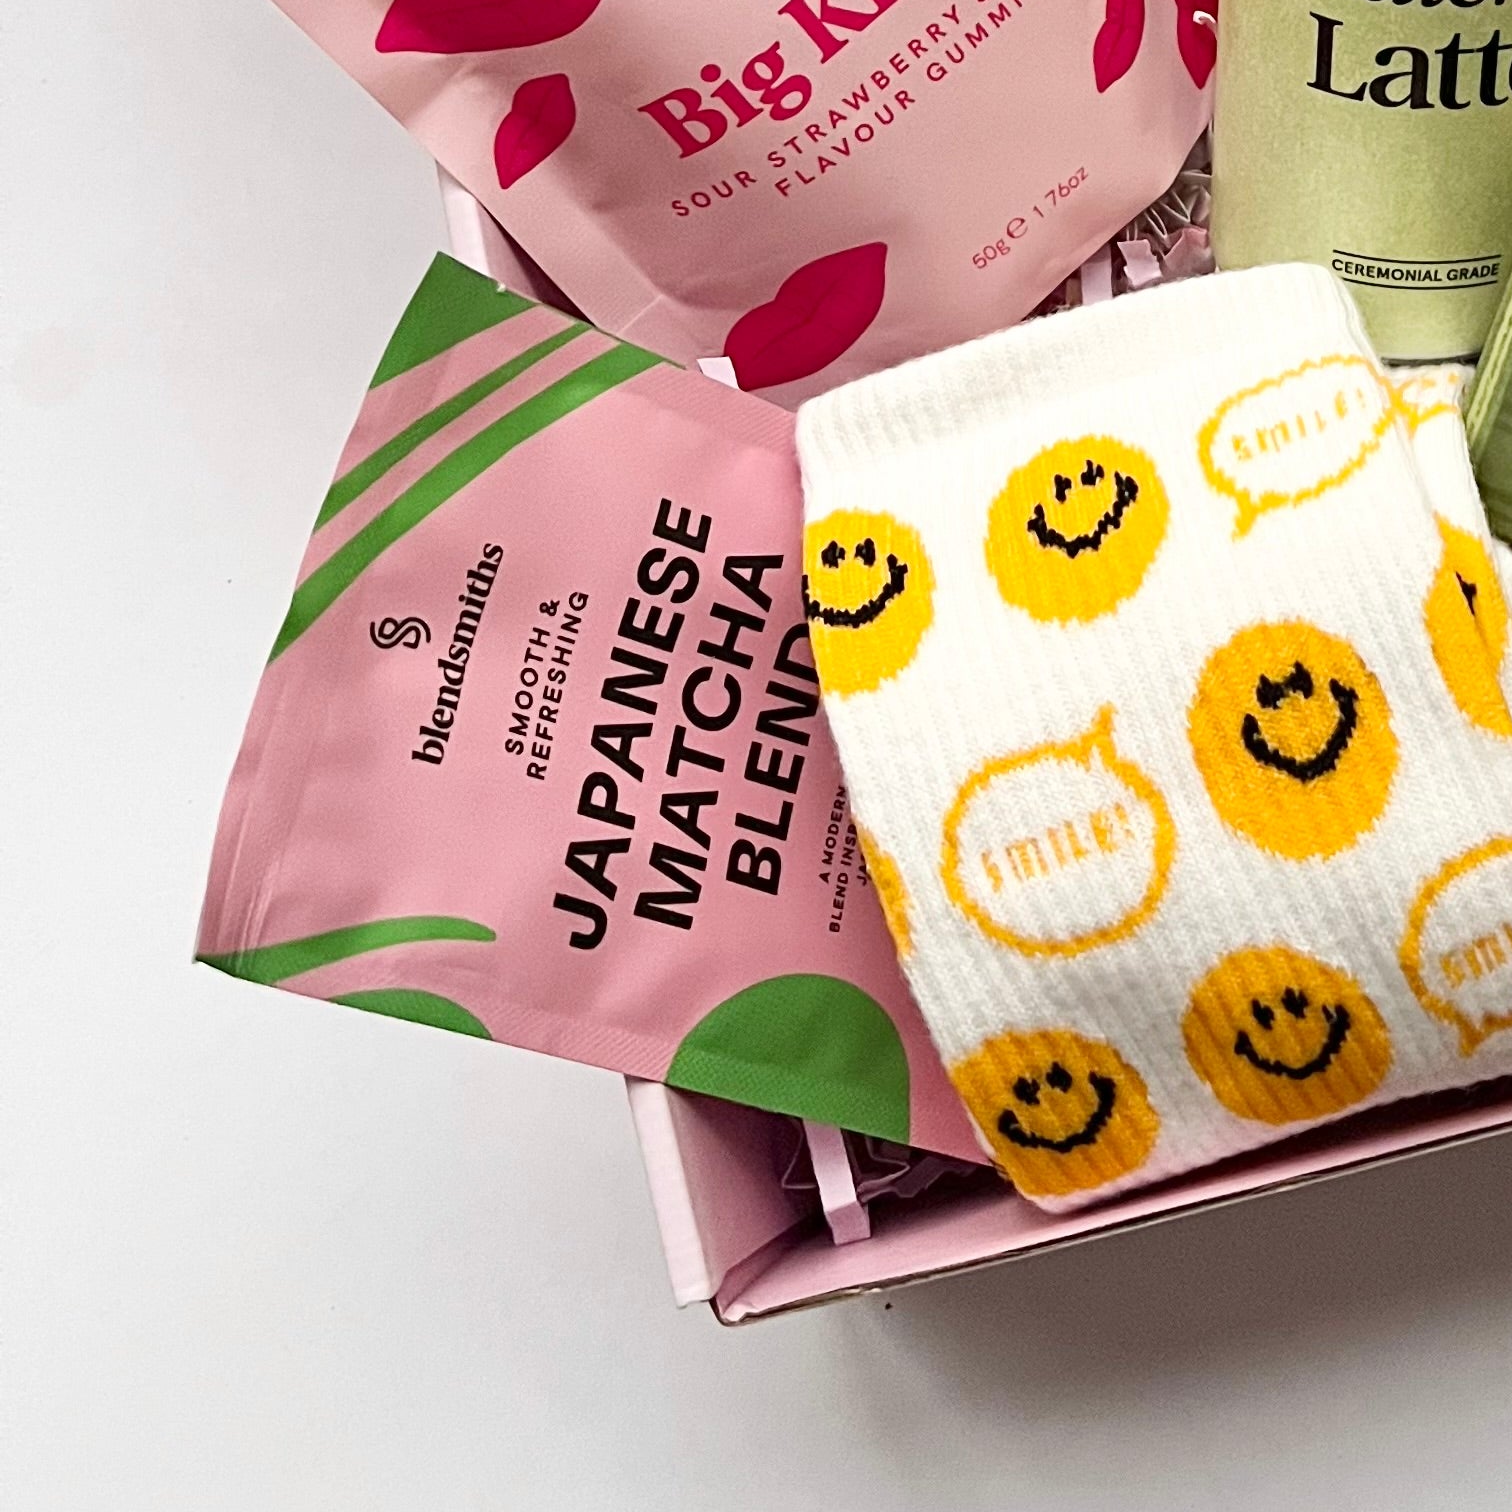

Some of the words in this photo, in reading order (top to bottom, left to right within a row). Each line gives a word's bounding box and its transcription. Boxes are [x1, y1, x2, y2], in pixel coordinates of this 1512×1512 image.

[637, 40, 813, 159] Big
[671, 170, 757, 217] SOUR
[767, 4, 961, 169] STRAWBERRY
[774, 90, 916, 198] FLAVOUR
[972, 238, 1011, 268] 50g
[1331, 258, 1443, 282] CEREMONIAL
[1446, 262, 1501, 281] GRADE
[411, 543, 504, 766] blendsmiths
[504, 628, 552, 756] SMOOTH
[539, 598, 560, 617] &
[526, 591, 590, 781] REFRESHING
[553, 498, 713, 951] JAPANESE
[633, 554, 785, 931] MATCHA
[726, 622, 820, 896] BLEND
[818, 872, 831, 884] A
[821, 785, 847, 865] MODERN
[828, 872, 849, 933] BLEND
